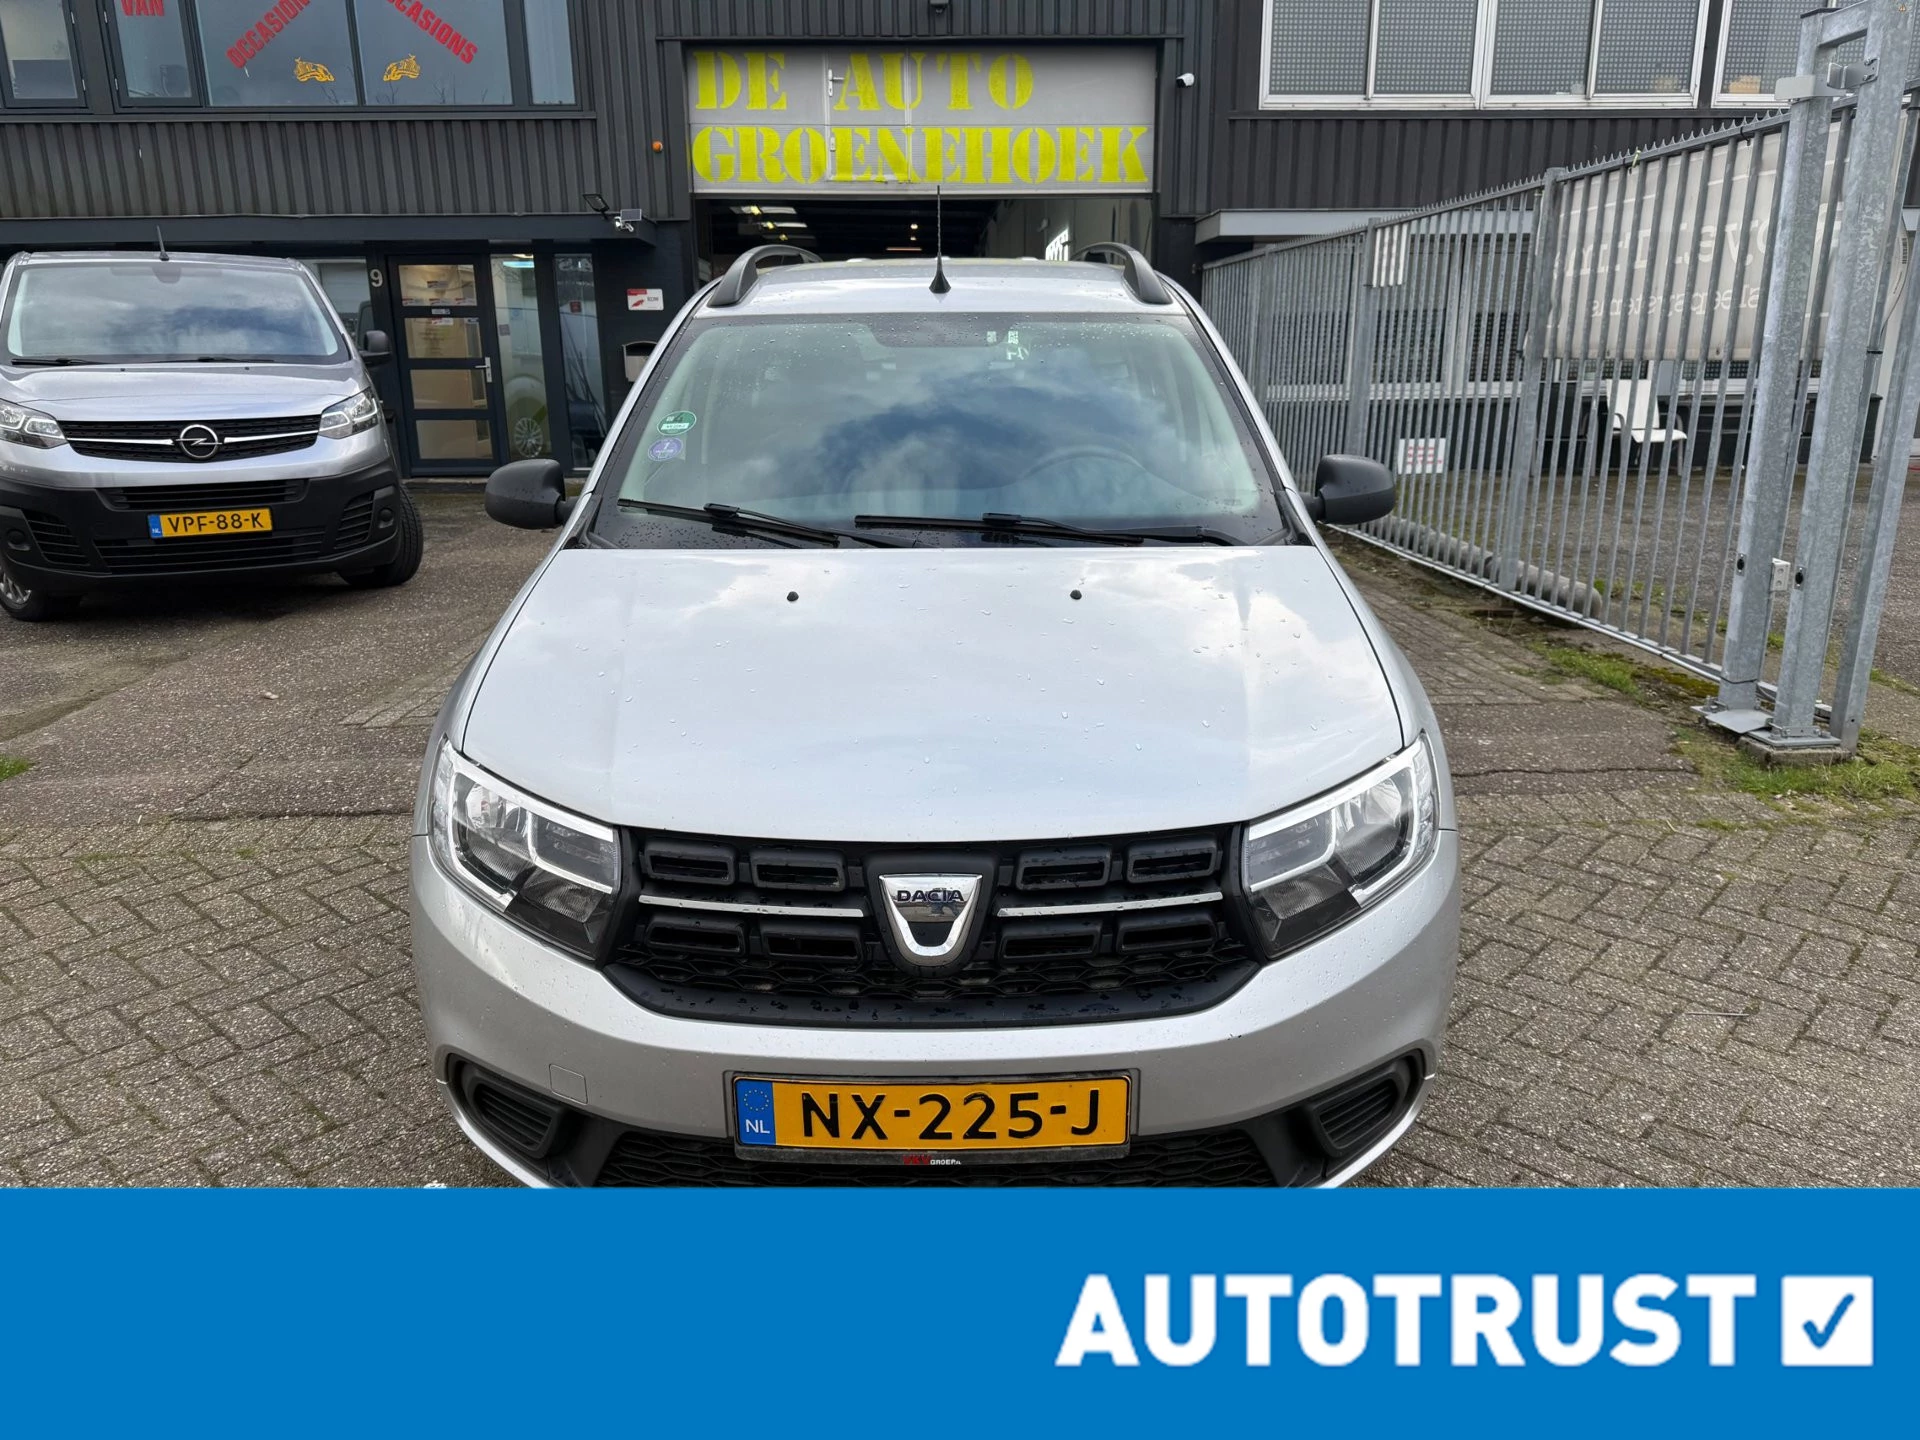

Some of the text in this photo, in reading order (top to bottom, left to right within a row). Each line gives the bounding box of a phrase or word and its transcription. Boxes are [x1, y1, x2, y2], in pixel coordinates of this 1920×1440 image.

[692, 52, 1034, 111] DE AUTO
[692, 126, 1149, 184] GROENEHOEK
[370, 269, 383, 288] 9
[168, 513, 264, 533] VPF-88-K
[897, 890, 964, 902] DACIA
[802, 1089, 1100, 1140] NX-225-J
[745, 1119, 770, 1134] NL
